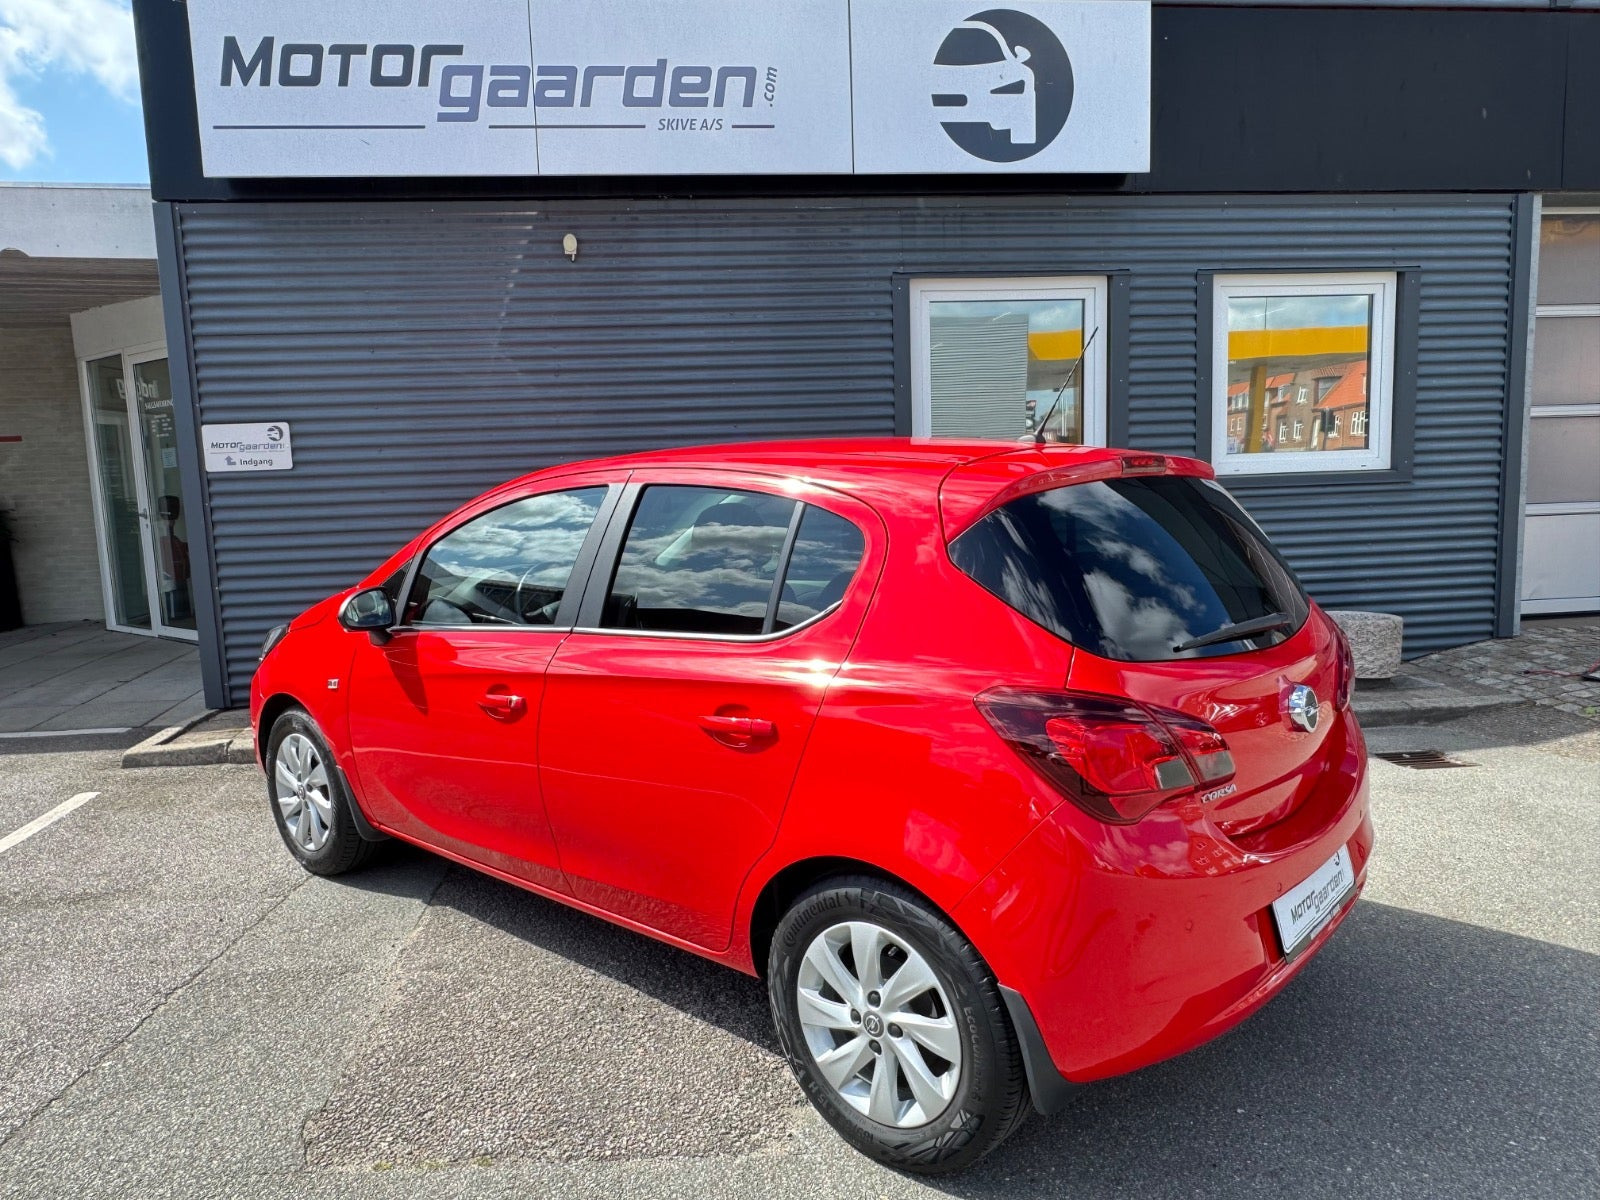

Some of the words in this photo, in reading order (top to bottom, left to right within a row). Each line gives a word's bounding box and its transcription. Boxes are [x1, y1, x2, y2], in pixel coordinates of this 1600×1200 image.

[763, 66, 778, 108] .com
[657, 118, 698, 131] SKIVE
[699, 118, 724, 131] A/S
[240, 458, 273, 467] Indgang
[1200, 783, 1238, 804] CORSA
[783, 890, 844, 947] Continental
